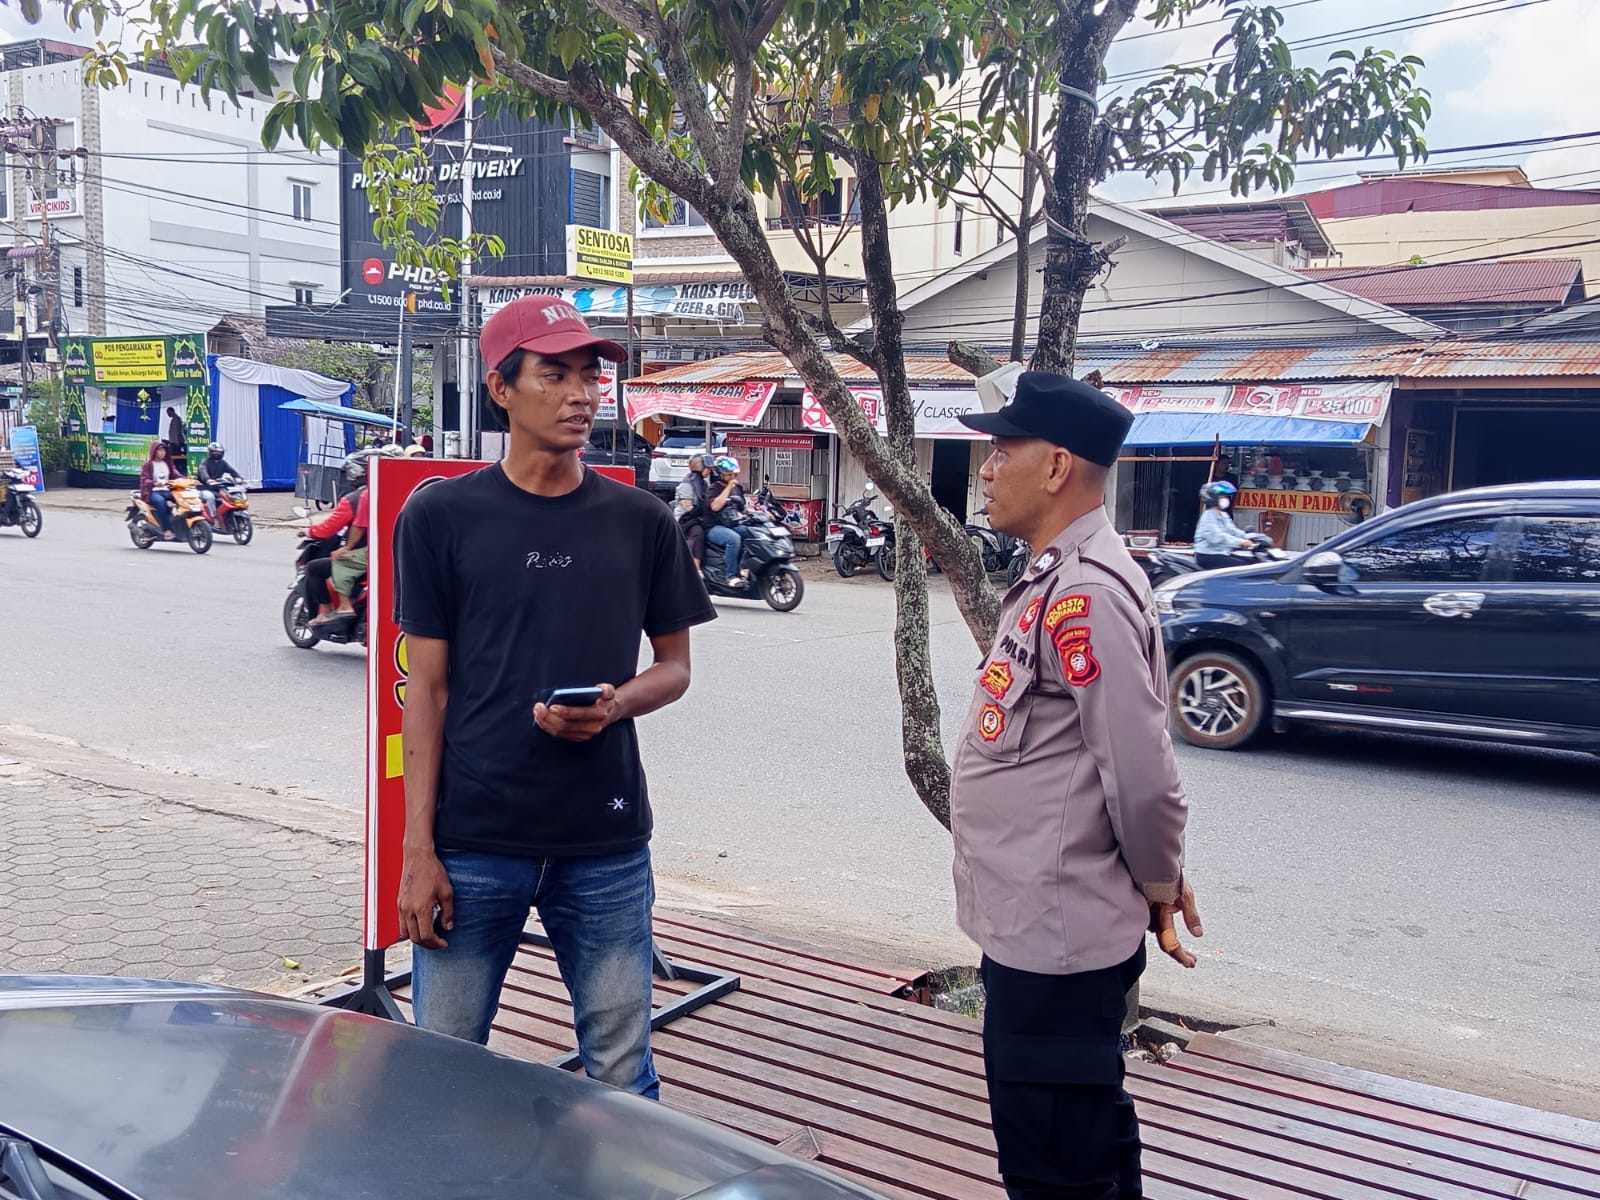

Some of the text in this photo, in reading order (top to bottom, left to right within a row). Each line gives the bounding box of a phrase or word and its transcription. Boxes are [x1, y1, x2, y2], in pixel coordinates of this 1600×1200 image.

[578, 228, 630, 254] SENTOSA
[489, 287, 521, 304] KAOS
[680, 283, 718, 299] KAOS
[373, 295, 392, 306] 1500
[674, 302, 703, 314] ECER
[706, 303, 715, 315] &
[116, 343, 152, 351] PENGAMANAN
[654, 384, 704, 395] GORENG
[706, 384, 745, 398] ABAH
[1301, 389, 1321, 397] NEW
[924, 406, 973, 418] CLASSIC
[999, 634, 1035, 670] POLRI
